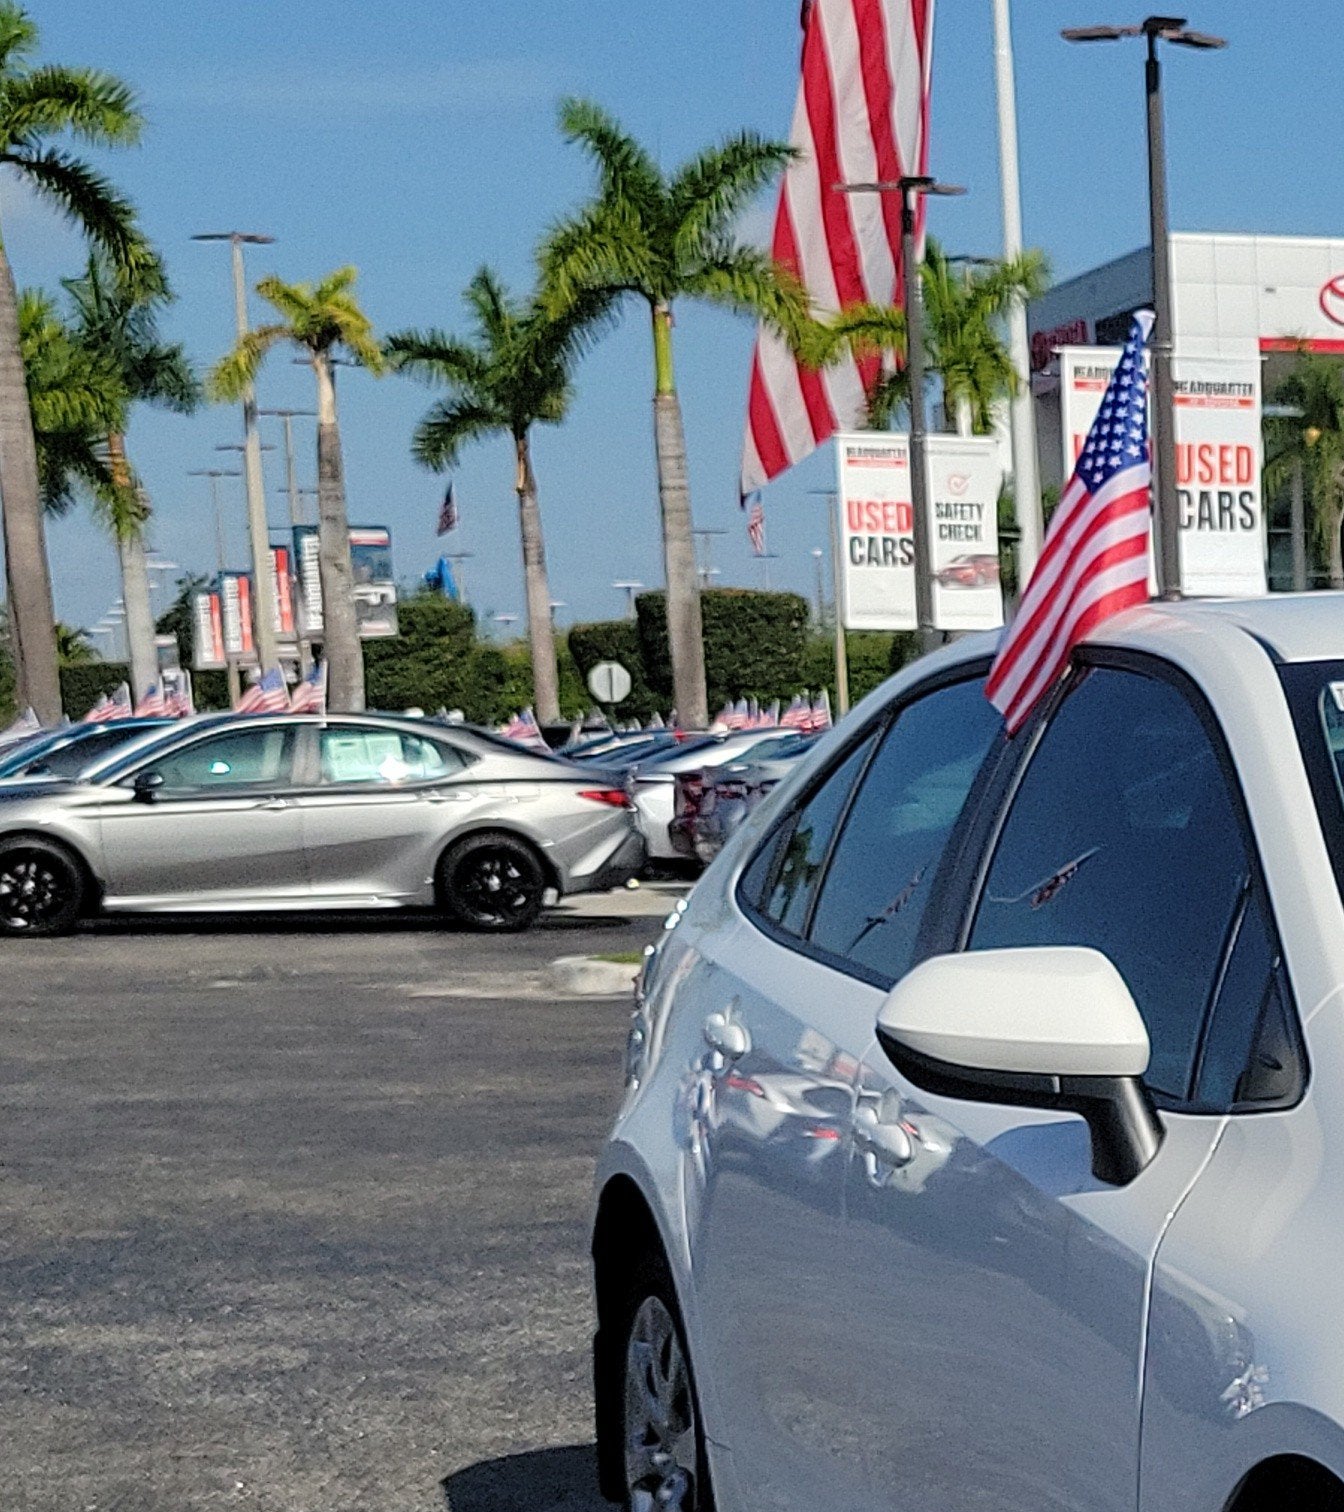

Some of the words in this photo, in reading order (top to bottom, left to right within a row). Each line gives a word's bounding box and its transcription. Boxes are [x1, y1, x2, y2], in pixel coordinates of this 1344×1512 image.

[1175, 444, 1253, 484] USED
[848, 501, 913, 532] USED
[935, 502, 983, 520] SAFETY
[1177, 490, 1254, 530] CARS
[938, 523, 983, 541] CHECK
[850, 536, 914, 566] CARS
